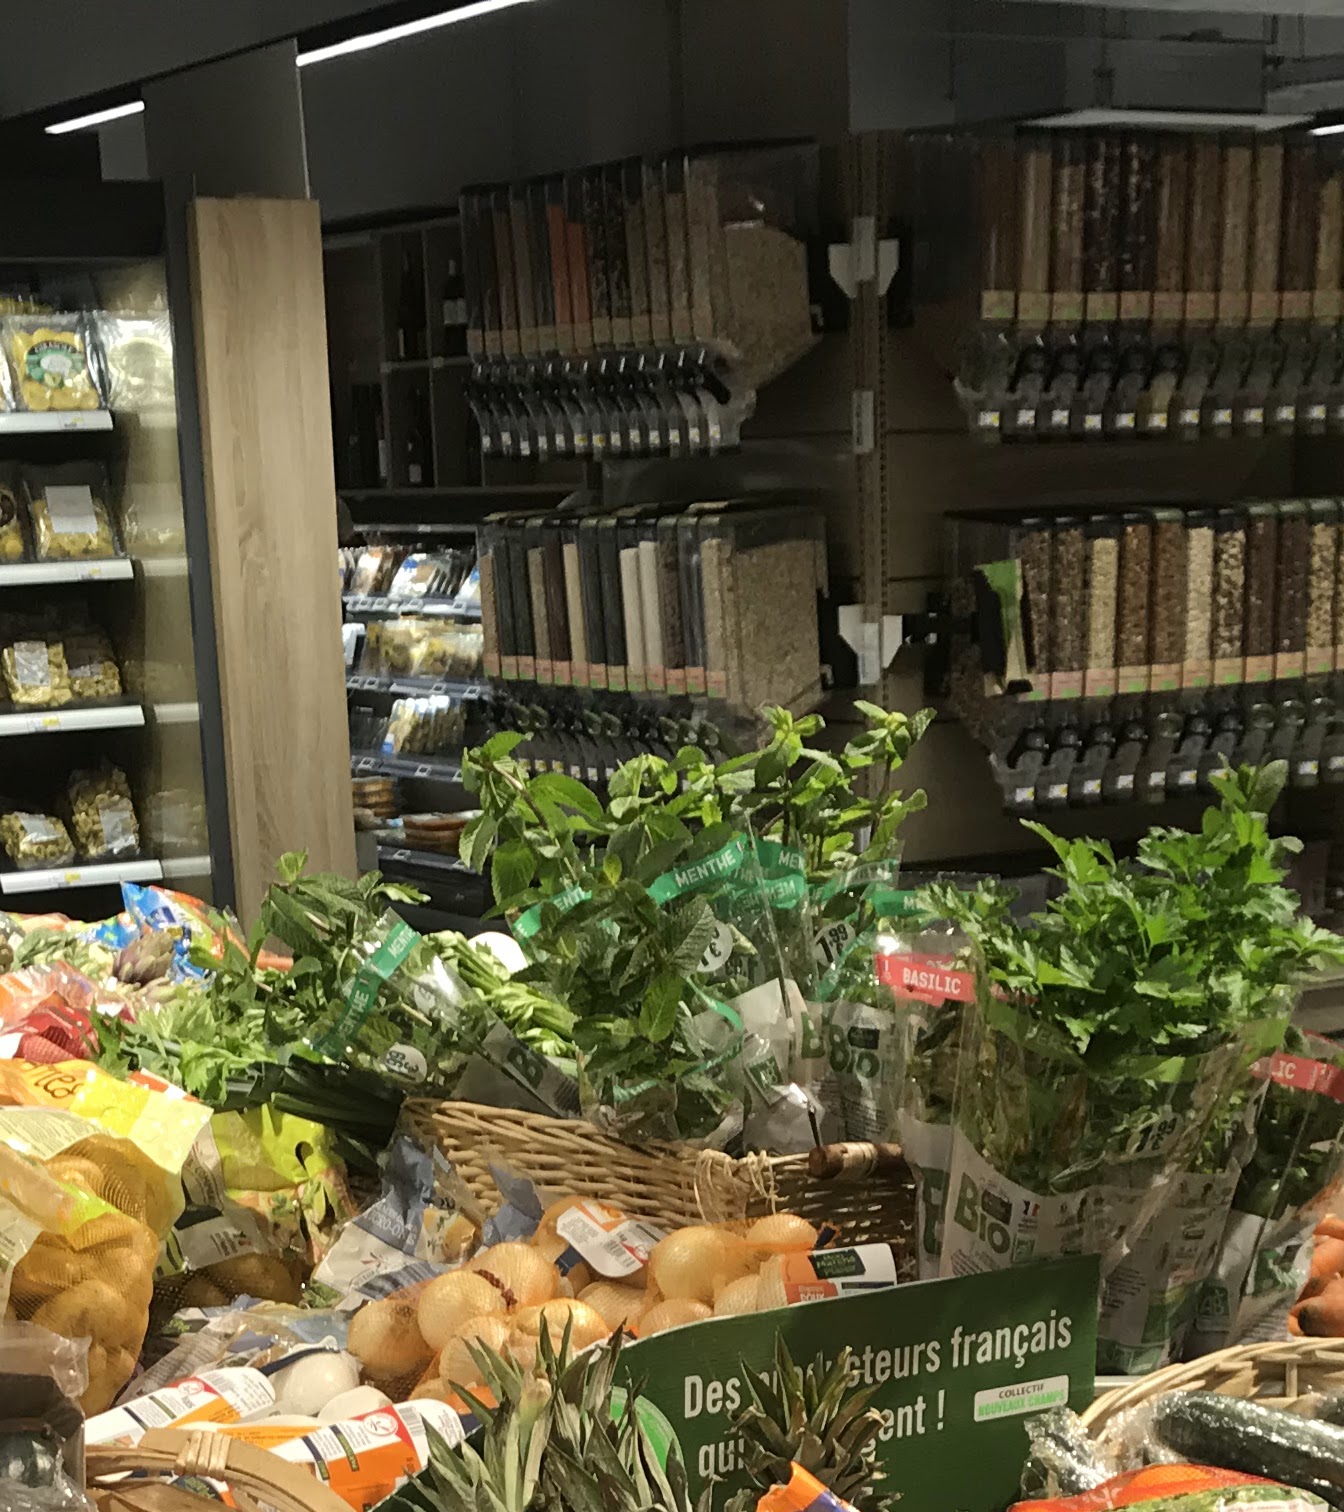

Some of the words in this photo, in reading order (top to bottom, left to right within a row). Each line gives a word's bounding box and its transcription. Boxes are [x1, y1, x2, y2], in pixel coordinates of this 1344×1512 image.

[676, 849, 736, 887] MENTHE
[902, 967, 962, 994] BASILIC
[684, 1374, 742, 1419] Des
[950, 1309, 1073, 1370] français
[998, 1382, 1045, 1400] COLLECTIF
